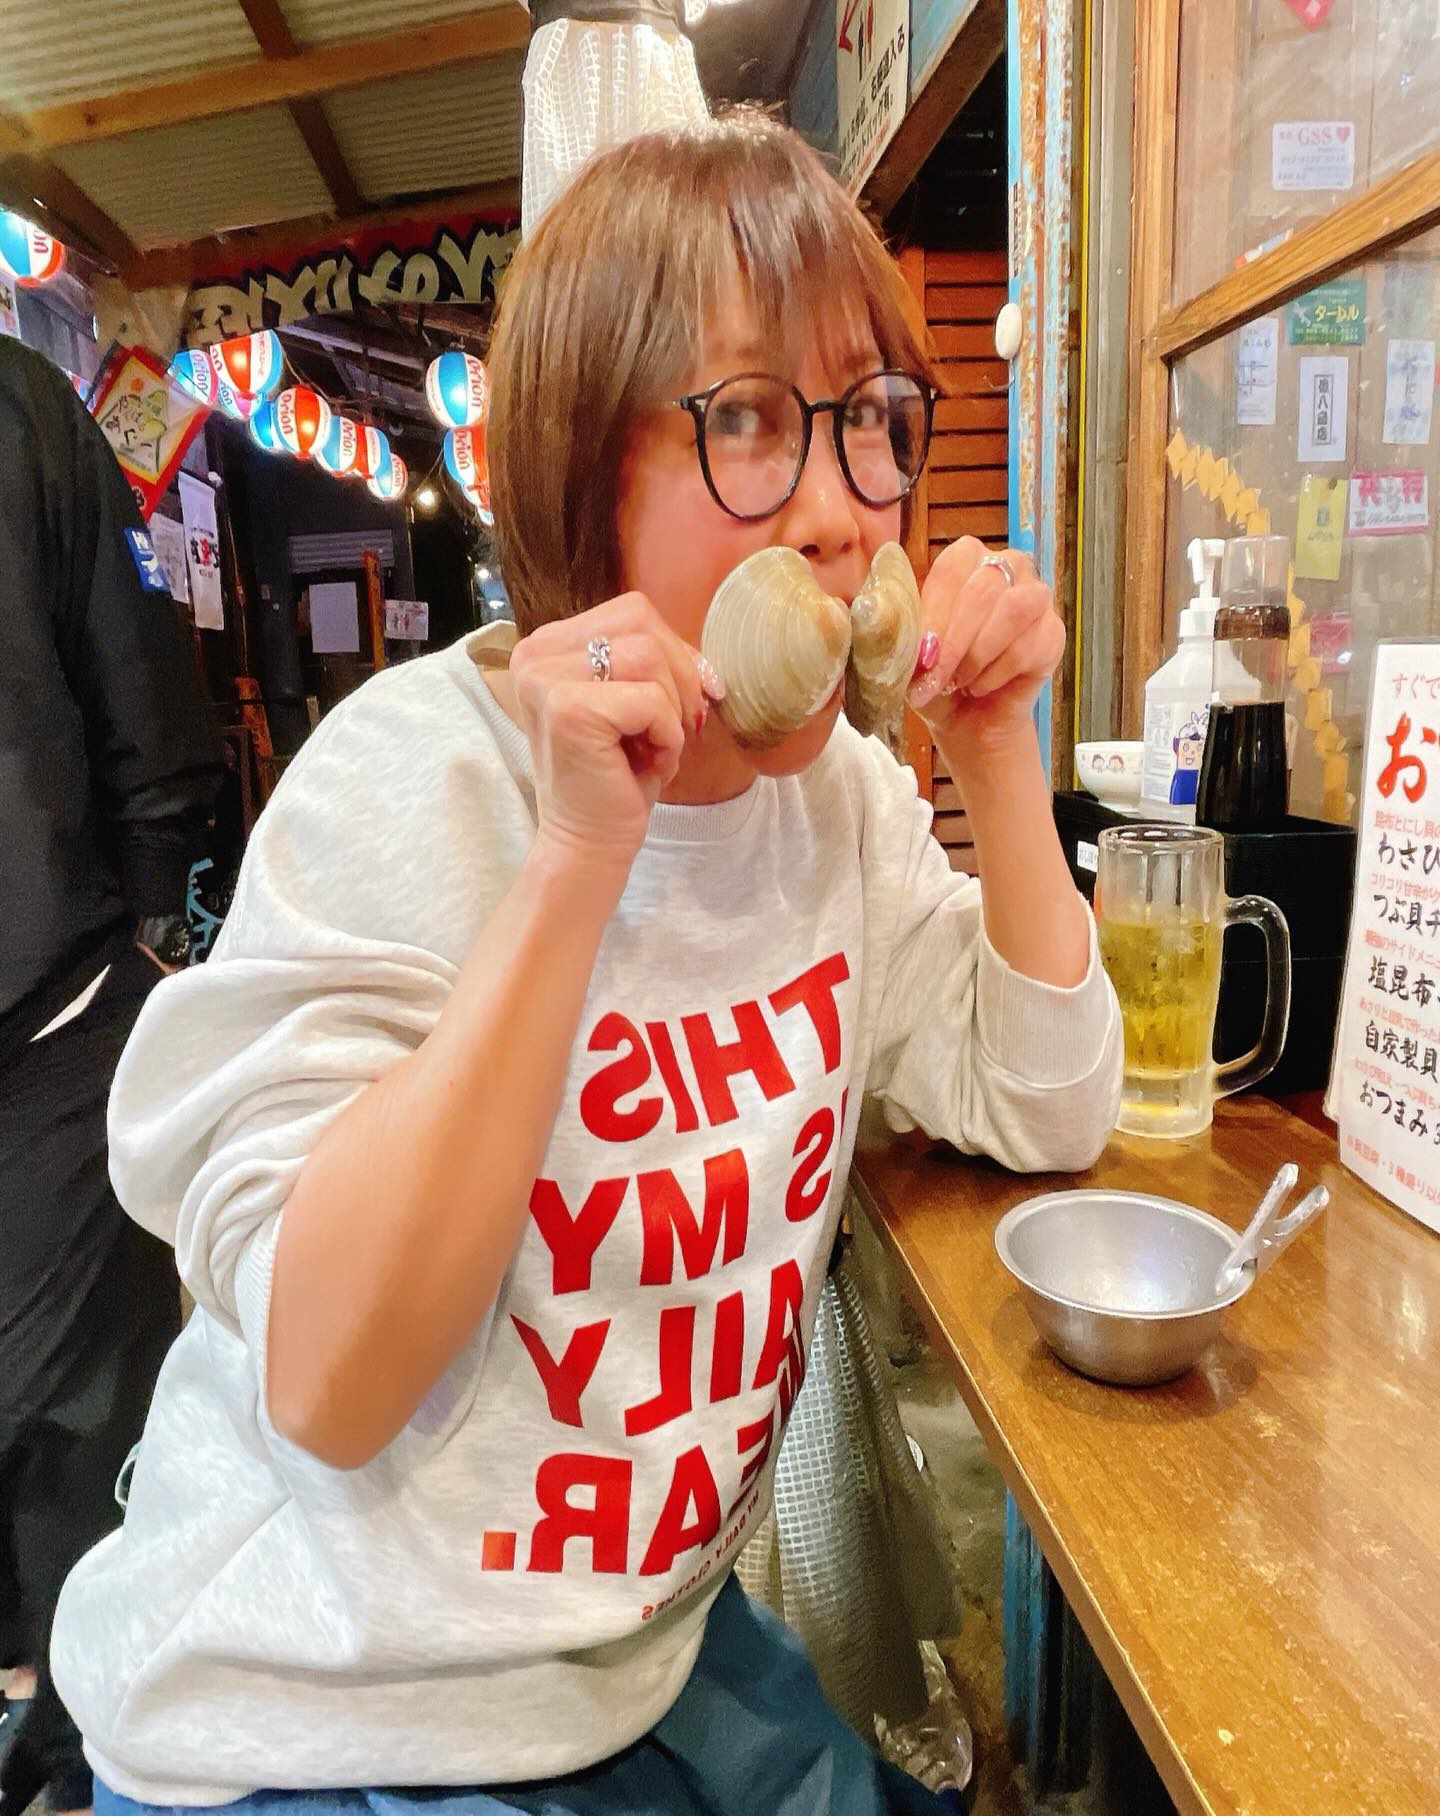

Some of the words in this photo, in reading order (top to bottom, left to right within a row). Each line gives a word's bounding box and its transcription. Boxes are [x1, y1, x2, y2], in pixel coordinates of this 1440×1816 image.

[467, 358, 483, 407] Orion
[281, 393, 294, 434] Orion
[340, 416, 353, 457] Orion
[1376, 712, 1440, 803] お
[1368, 955, 1440, 1008] 塩昆布
